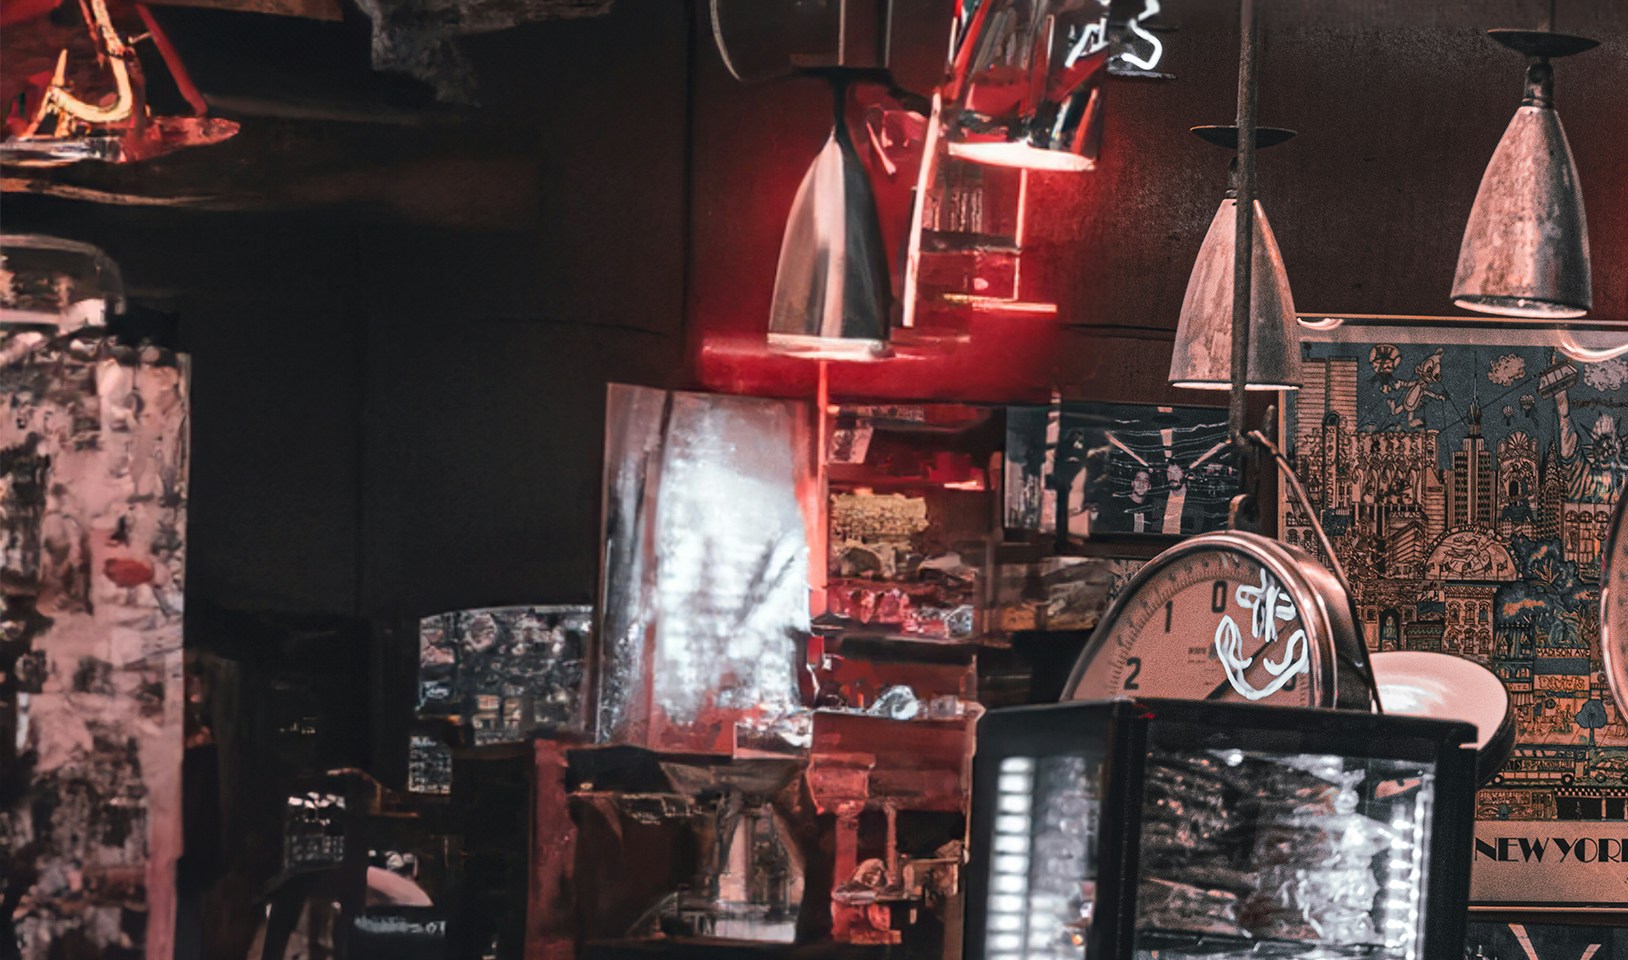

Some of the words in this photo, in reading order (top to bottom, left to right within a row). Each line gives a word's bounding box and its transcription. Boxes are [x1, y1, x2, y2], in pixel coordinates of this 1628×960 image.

[1211, 580, 1228, 613] 0
[1164, 600, 1173, 633] 1
[1123, 656, 1142, 690] 2
[1474, 836, 1550, 864] NEW
